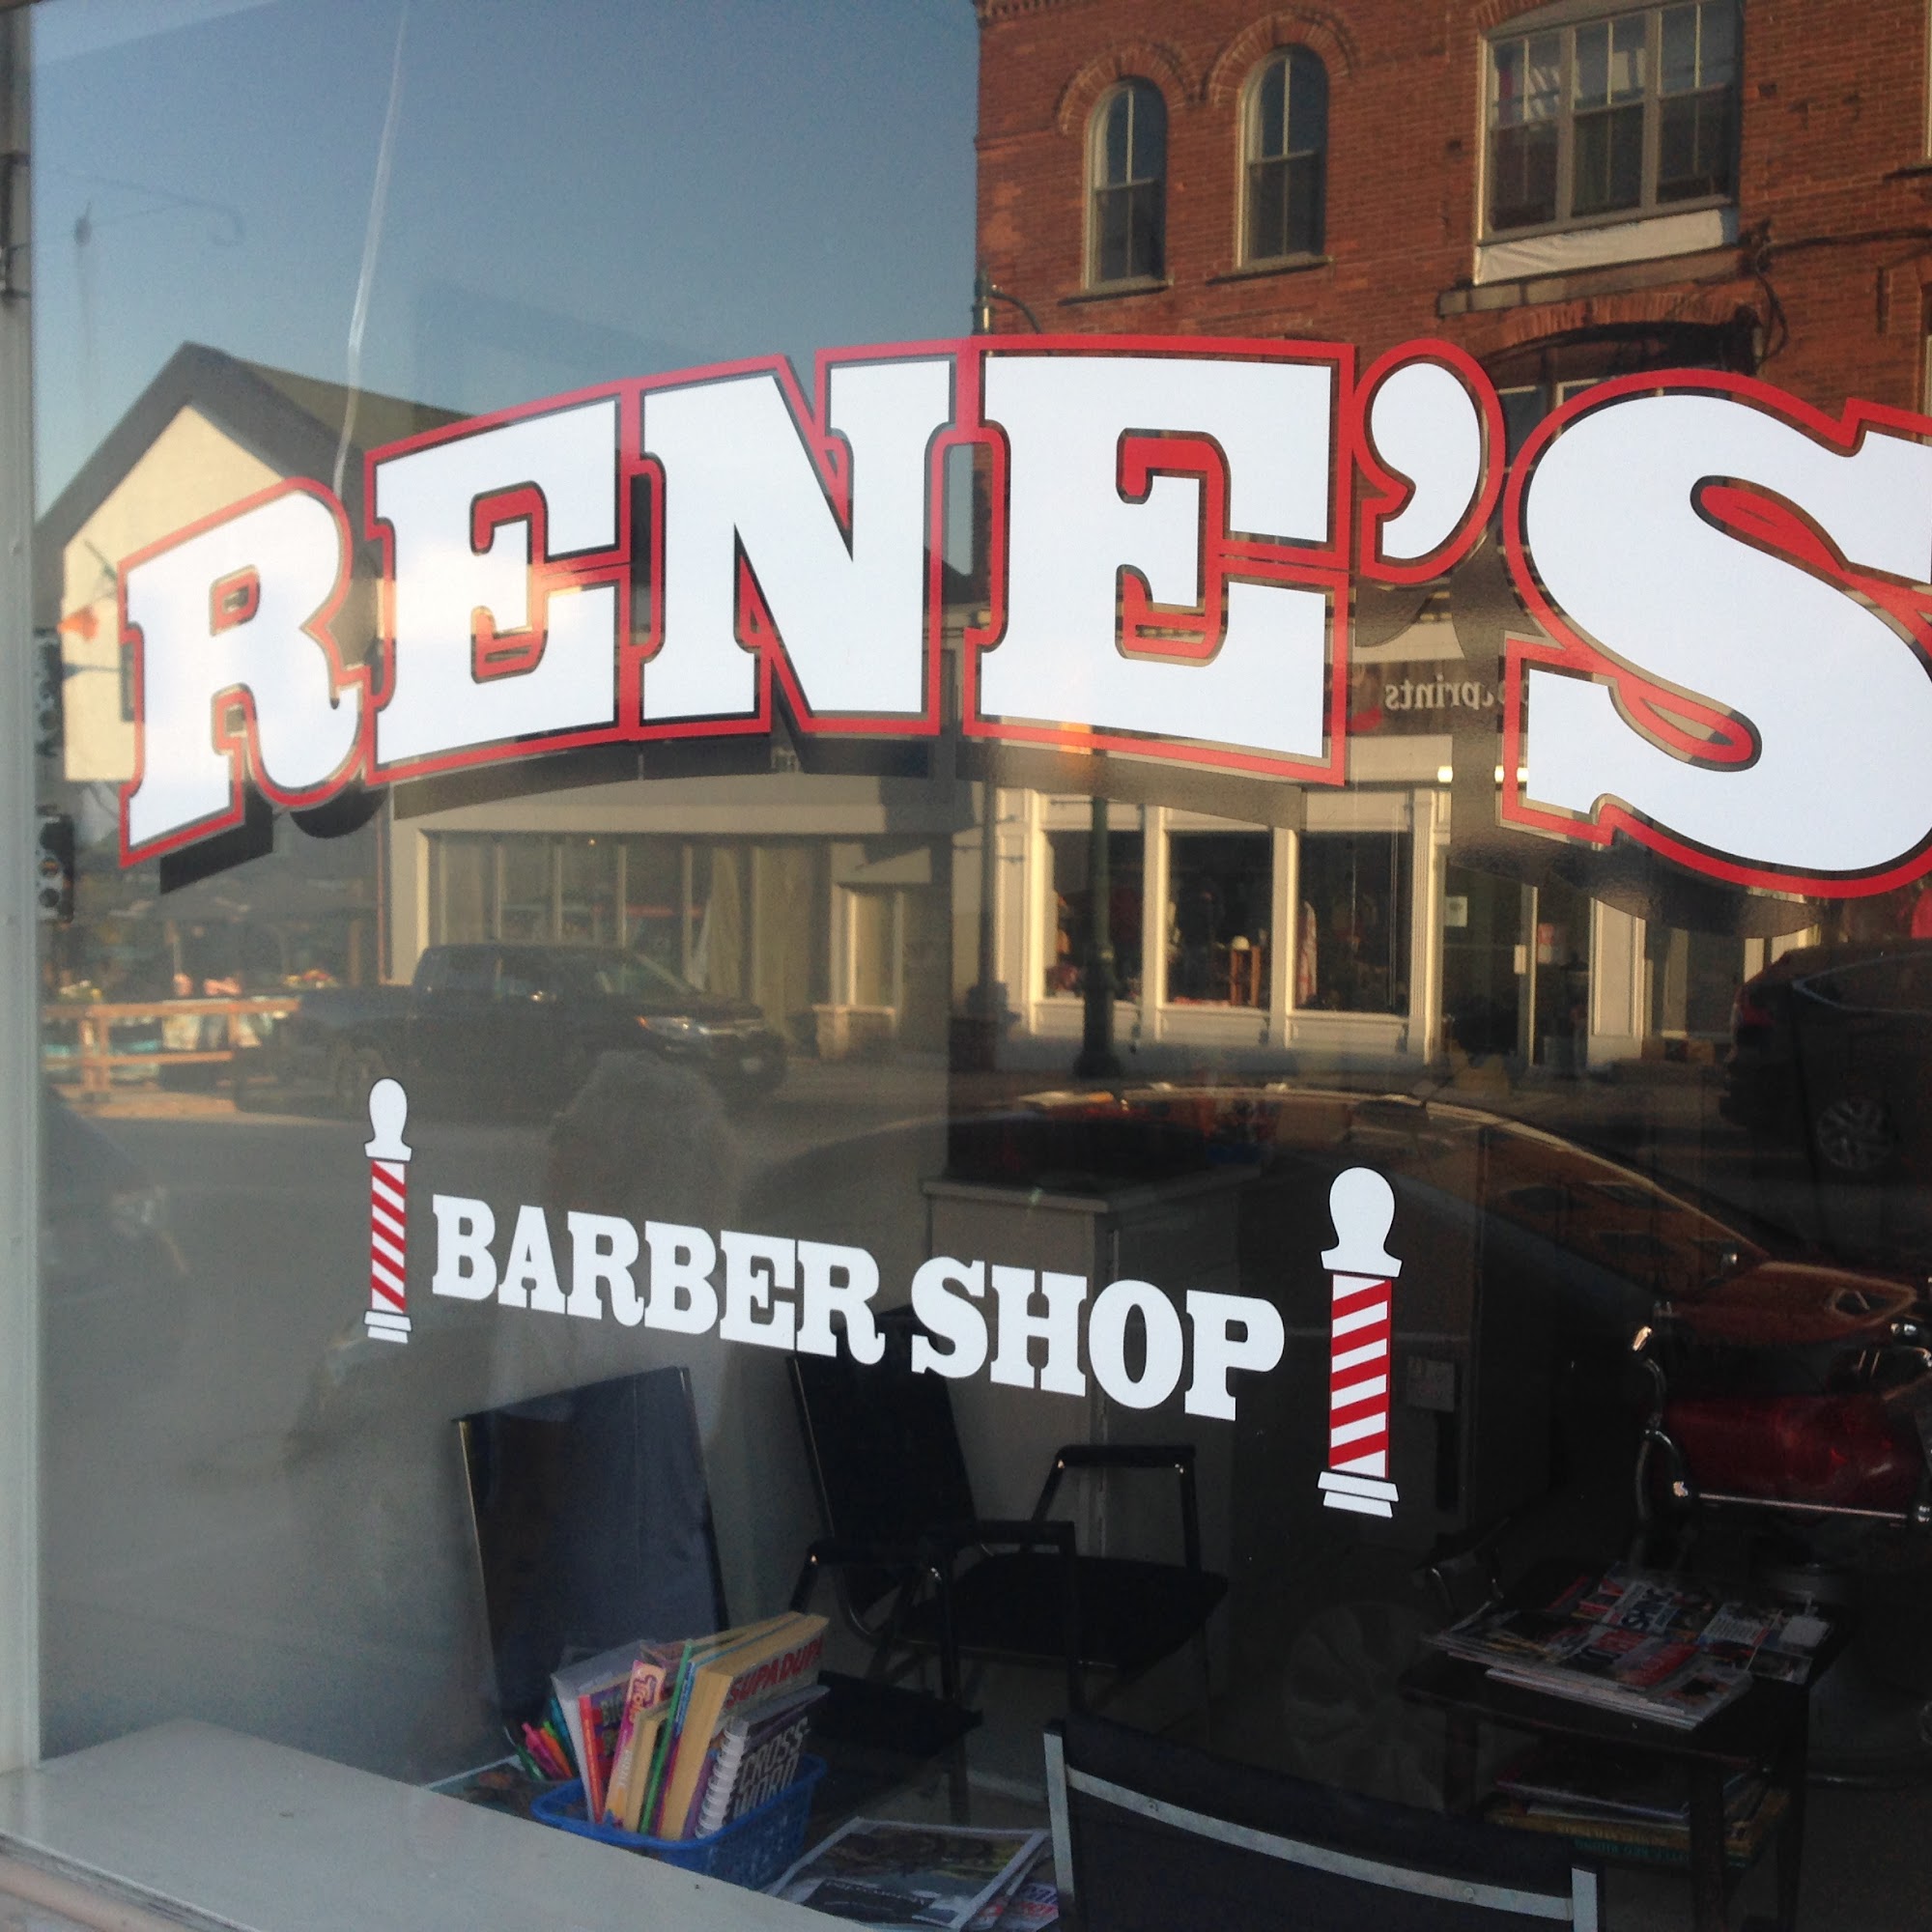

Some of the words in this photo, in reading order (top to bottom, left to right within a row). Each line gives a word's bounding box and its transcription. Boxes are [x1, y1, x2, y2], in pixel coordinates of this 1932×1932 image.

[118, 335, 1932, 898] RENE'S
[431, 1193, 887, 1367] BARBER
[909, 1256, 1286, 1422] SHOP
